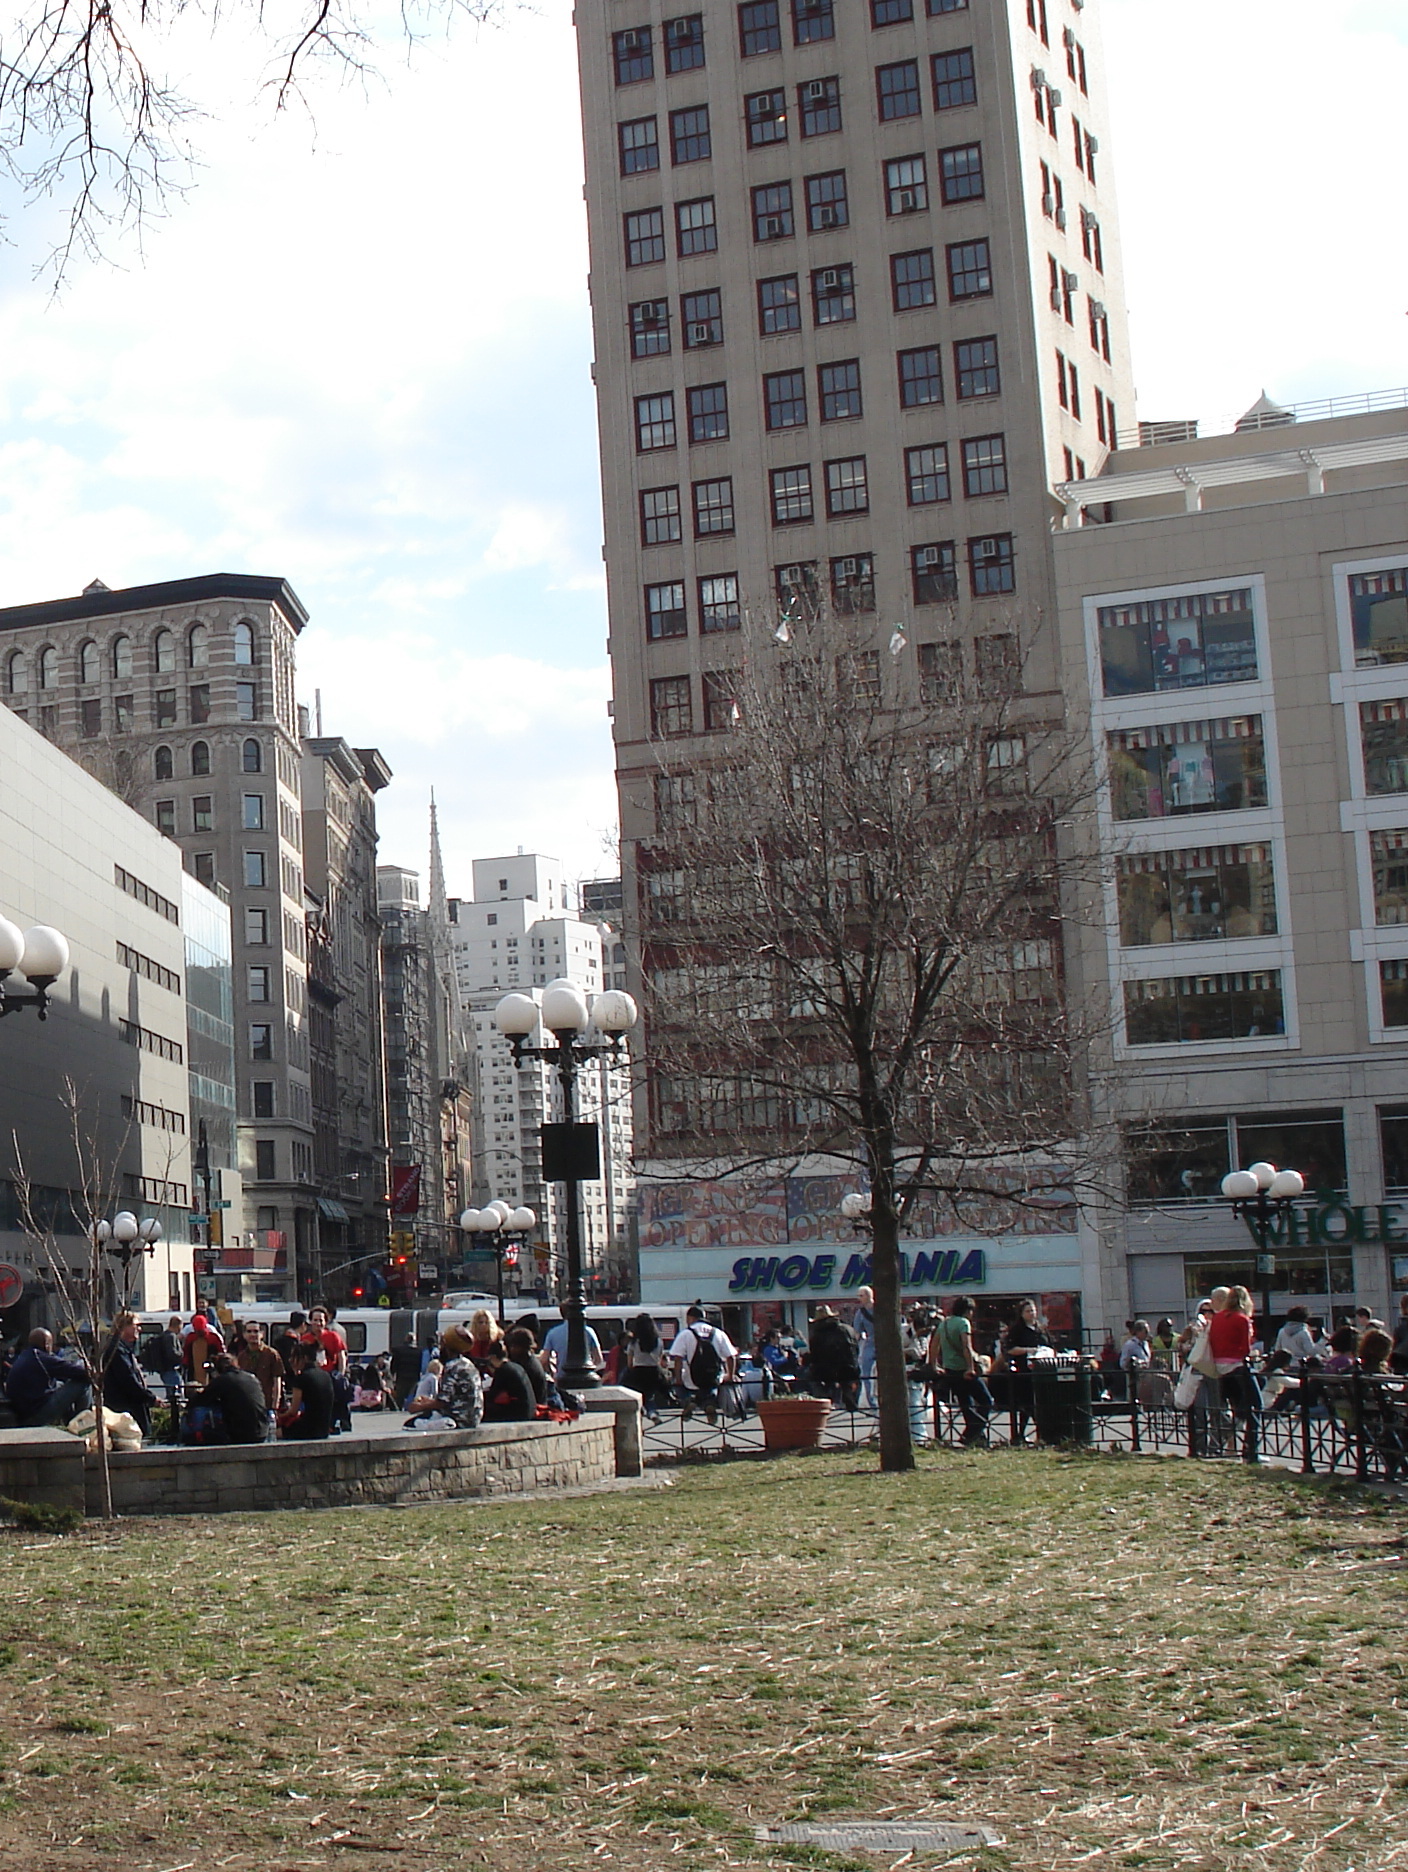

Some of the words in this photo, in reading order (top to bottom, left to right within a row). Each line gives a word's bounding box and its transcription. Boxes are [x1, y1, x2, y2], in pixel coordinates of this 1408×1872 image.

[396, 1166, 420, 1198] STRAND
[657, 1181, 758, 1213] GRAND
[647, 1215, 779, 1247] OPENING
[1241, 1204, 1407, 1246] WHOLE
[728, 1254, 836, 1292] SHOE
[840, 1249, 986, 1288] MNIA
